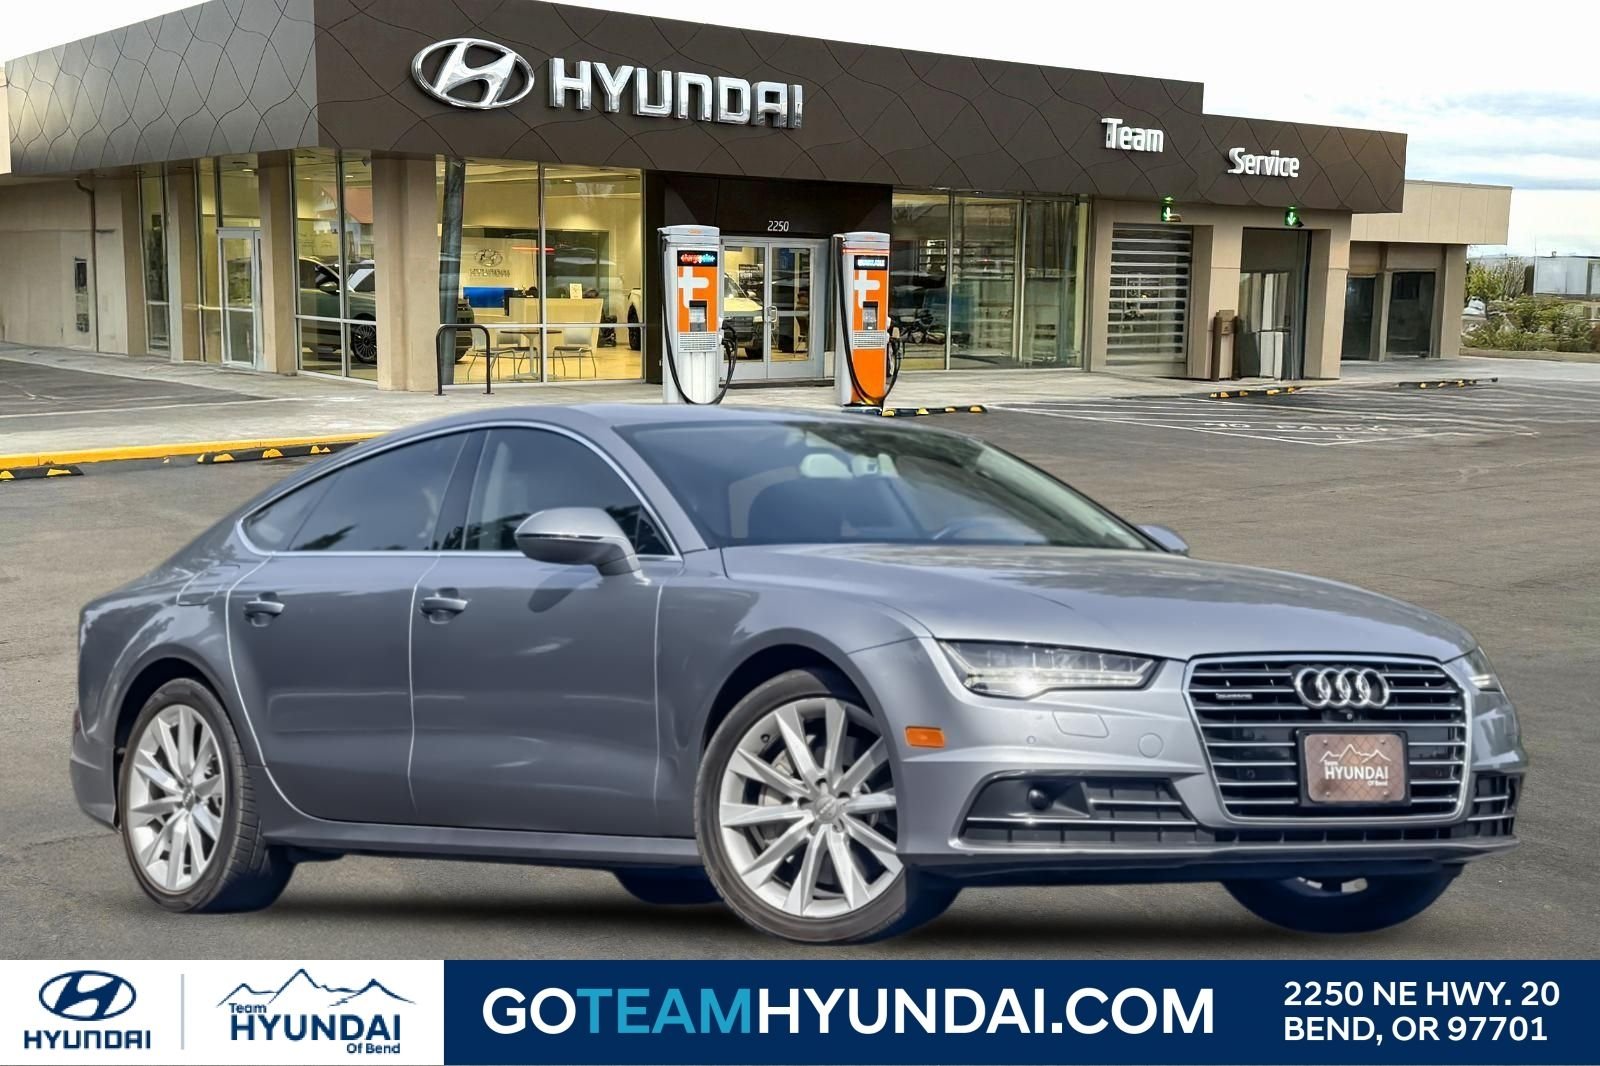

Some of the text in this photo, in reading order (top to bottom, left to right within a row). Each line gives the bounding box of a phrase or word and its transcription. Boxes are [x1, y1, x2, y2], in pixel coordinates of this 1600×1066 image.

[549, 57, 803, 129] HYUNDAI
[1101, 117, 1164, 153] Team
[1227, 147, 1300, 178] Service
[767, 220, 790, 232] 2250
[1325, 766, 1388, 780] HYUNDAI
